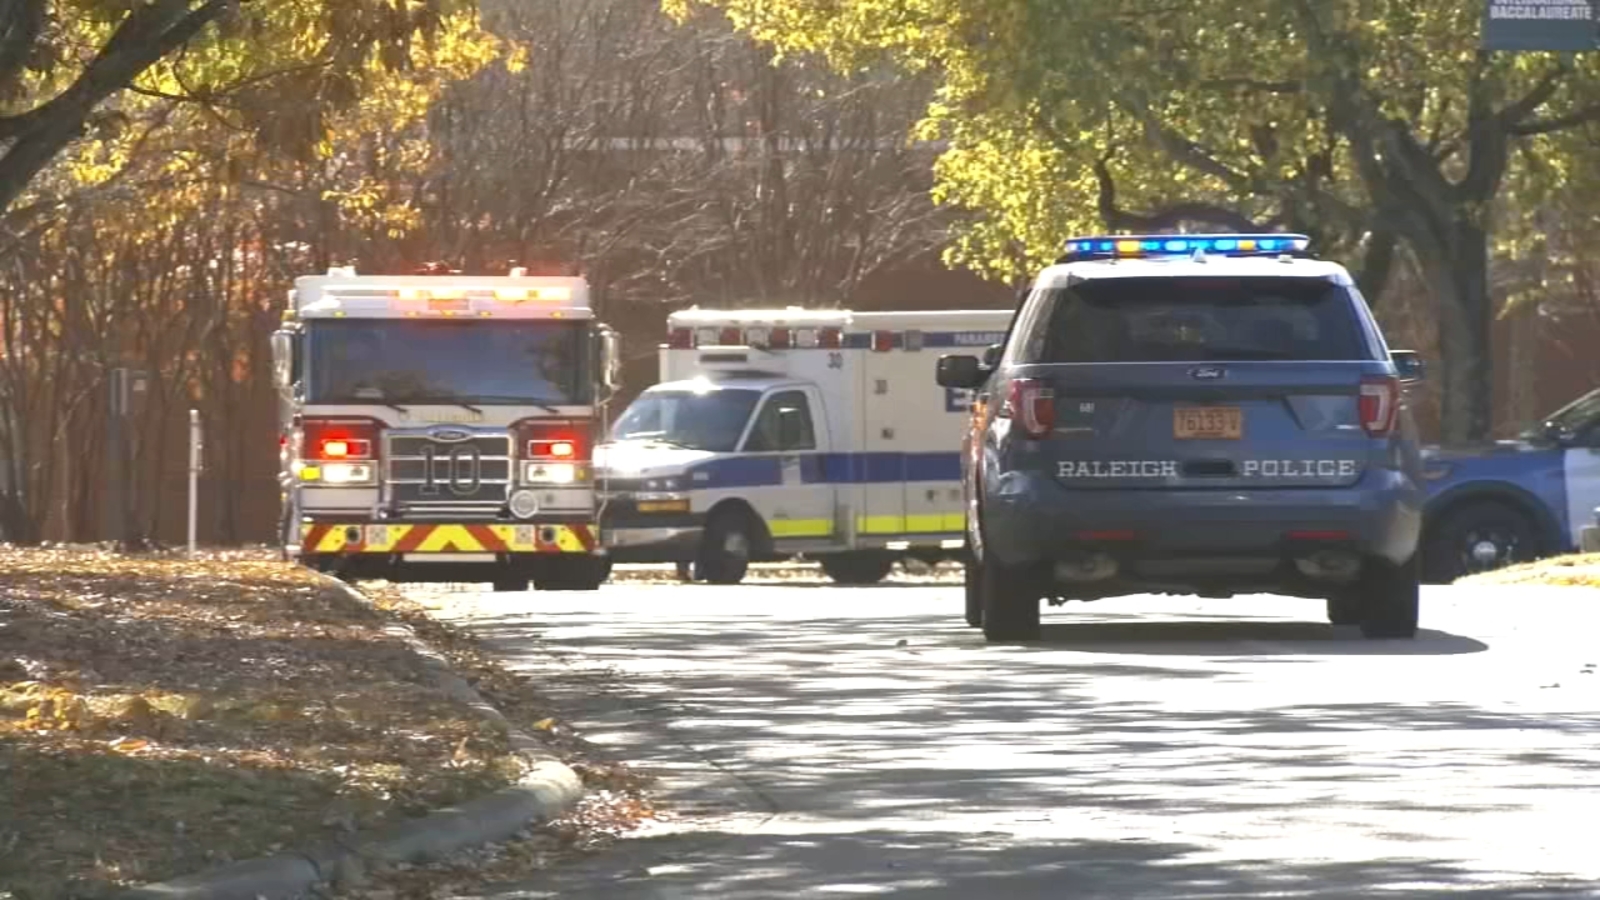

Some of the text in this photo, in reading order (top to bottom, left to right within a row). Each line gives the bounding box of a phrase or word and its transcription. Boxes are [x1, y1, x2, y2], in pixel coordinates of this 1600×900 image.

[1490, 6, 1593, 19] BACCALAUREATE
[419, 444, 481, 496] 10
[1057, 459, 1356, 478] RALEIGH POLICE
